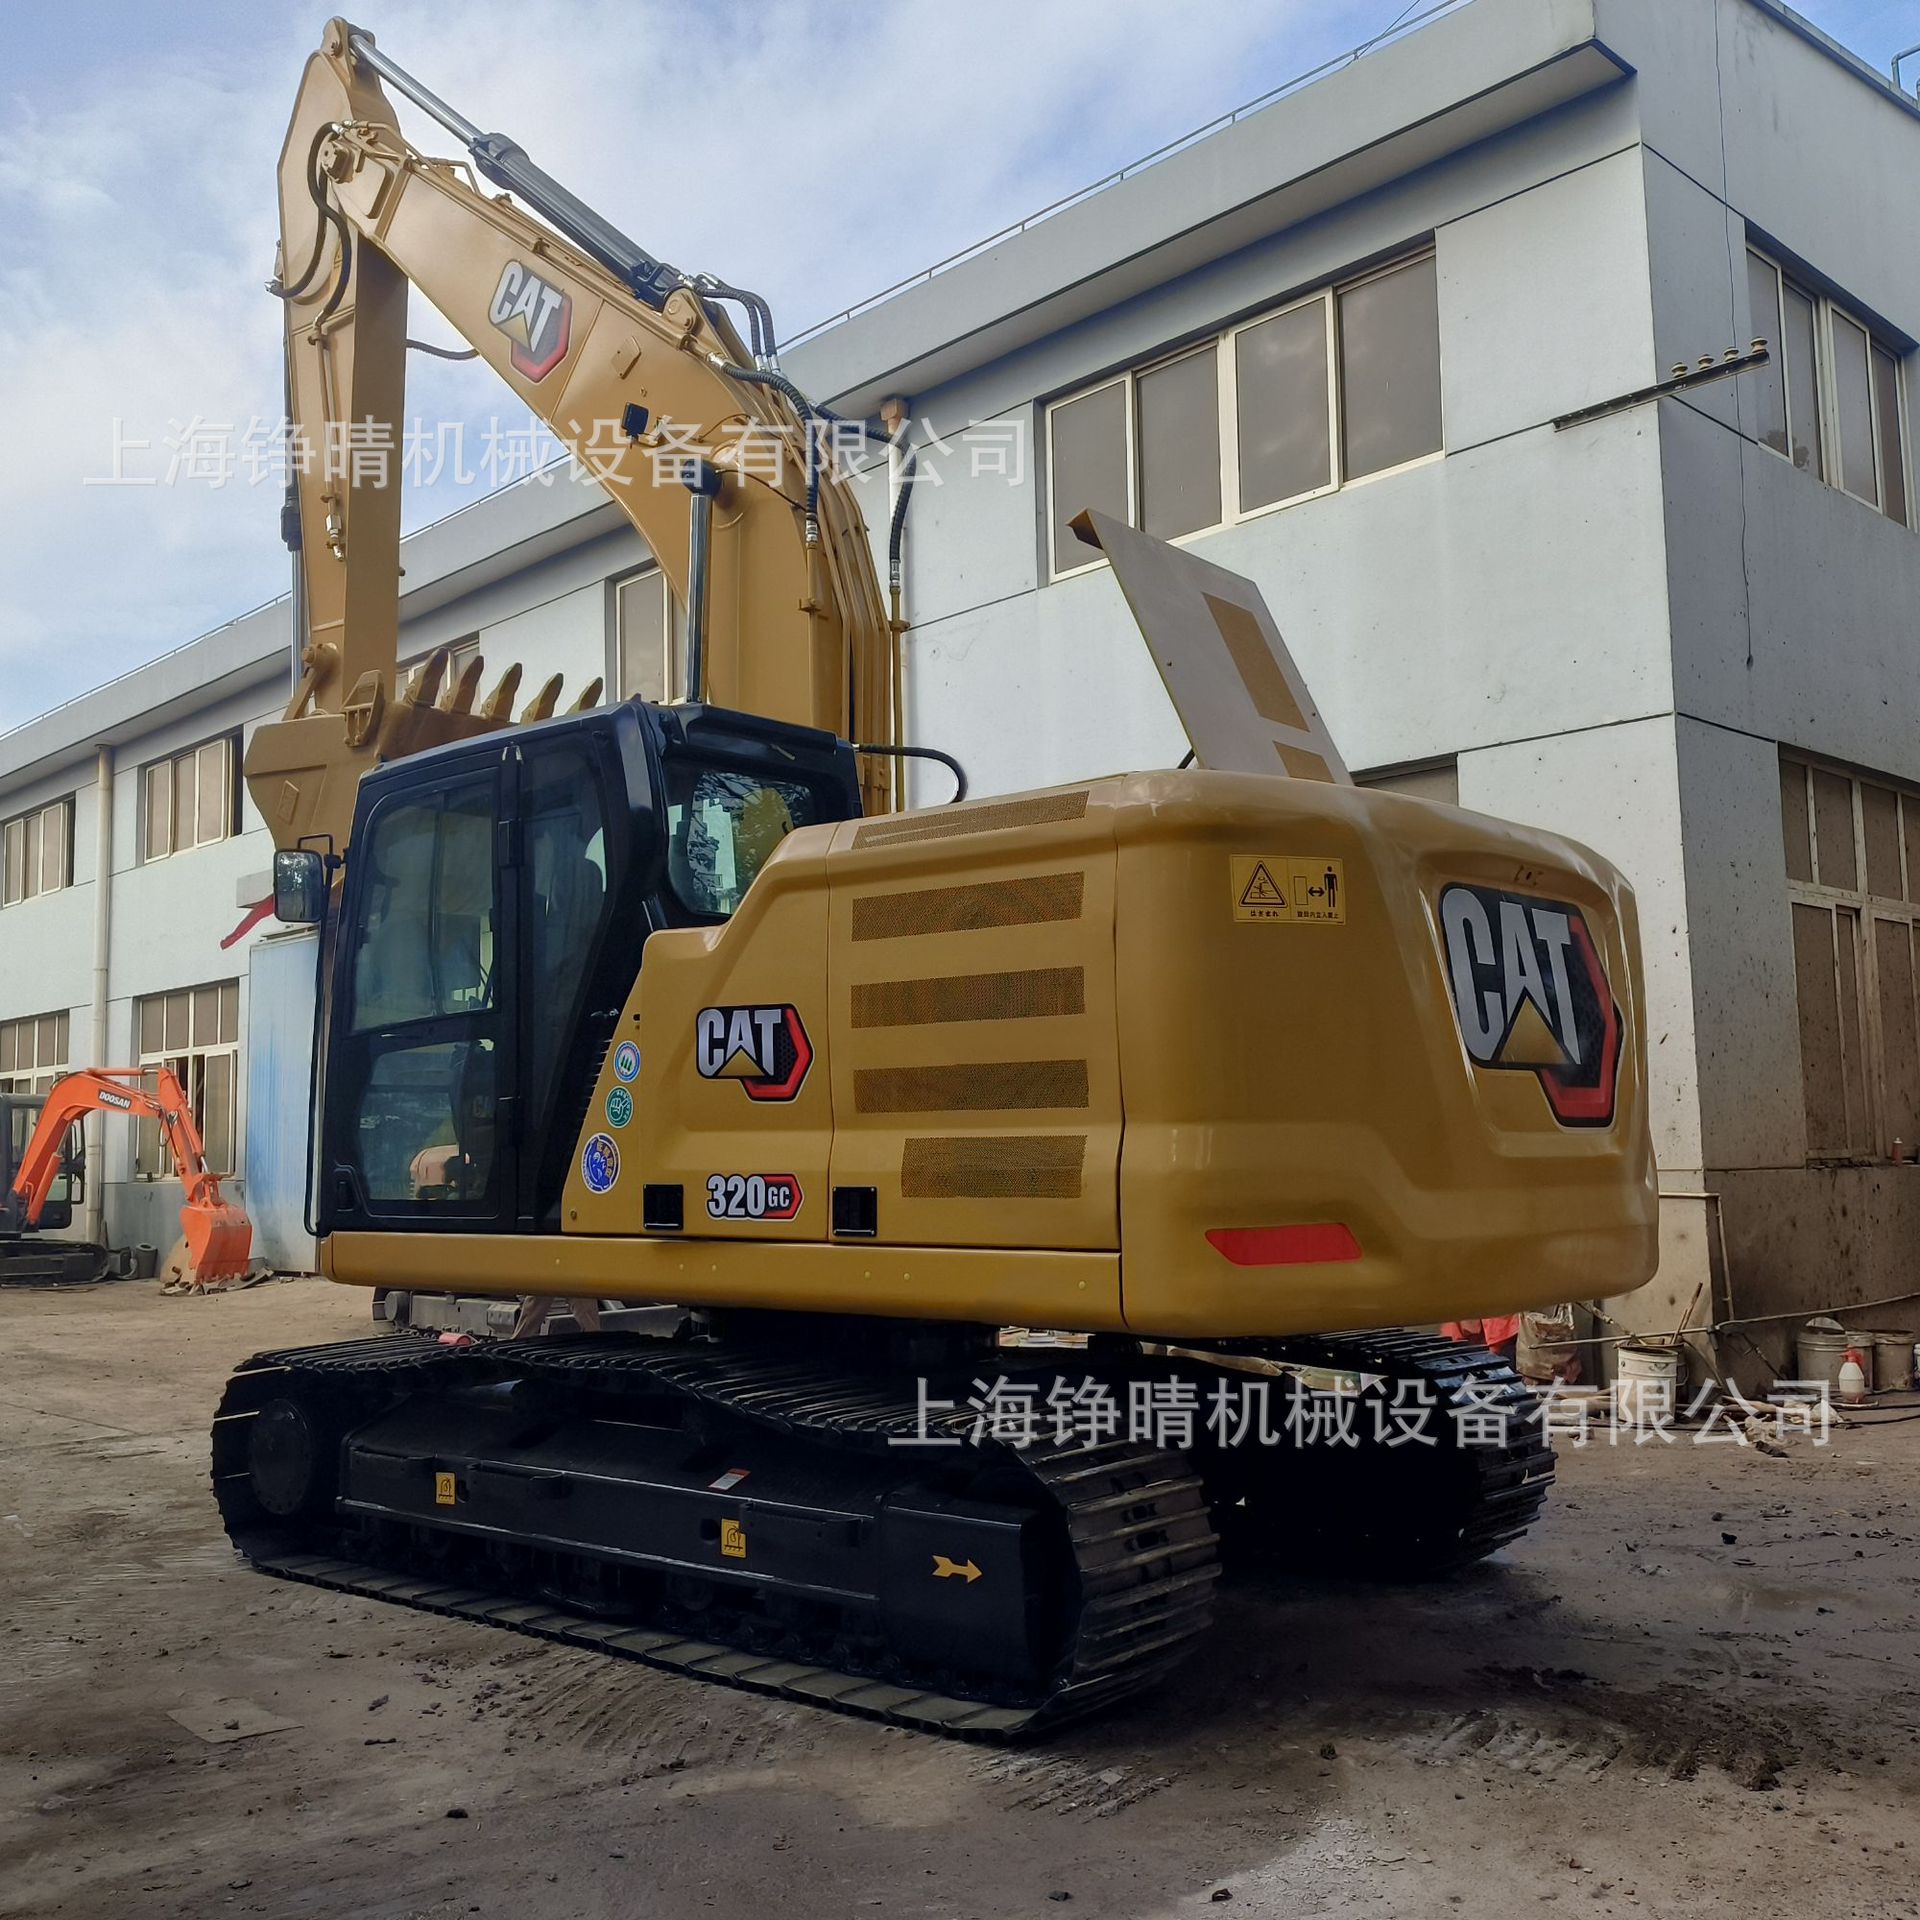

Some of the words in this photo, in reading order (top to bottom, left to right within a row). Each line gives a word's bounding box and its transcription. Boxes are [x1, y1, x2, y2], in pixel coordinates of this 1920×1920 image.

[489, 260, 562, 353] CAT
[1442, 887, 1582, 1065] CAT
[697, 1008, 782, 1076] CAT
[99, 1091, 131, 1109] DOOSAN
